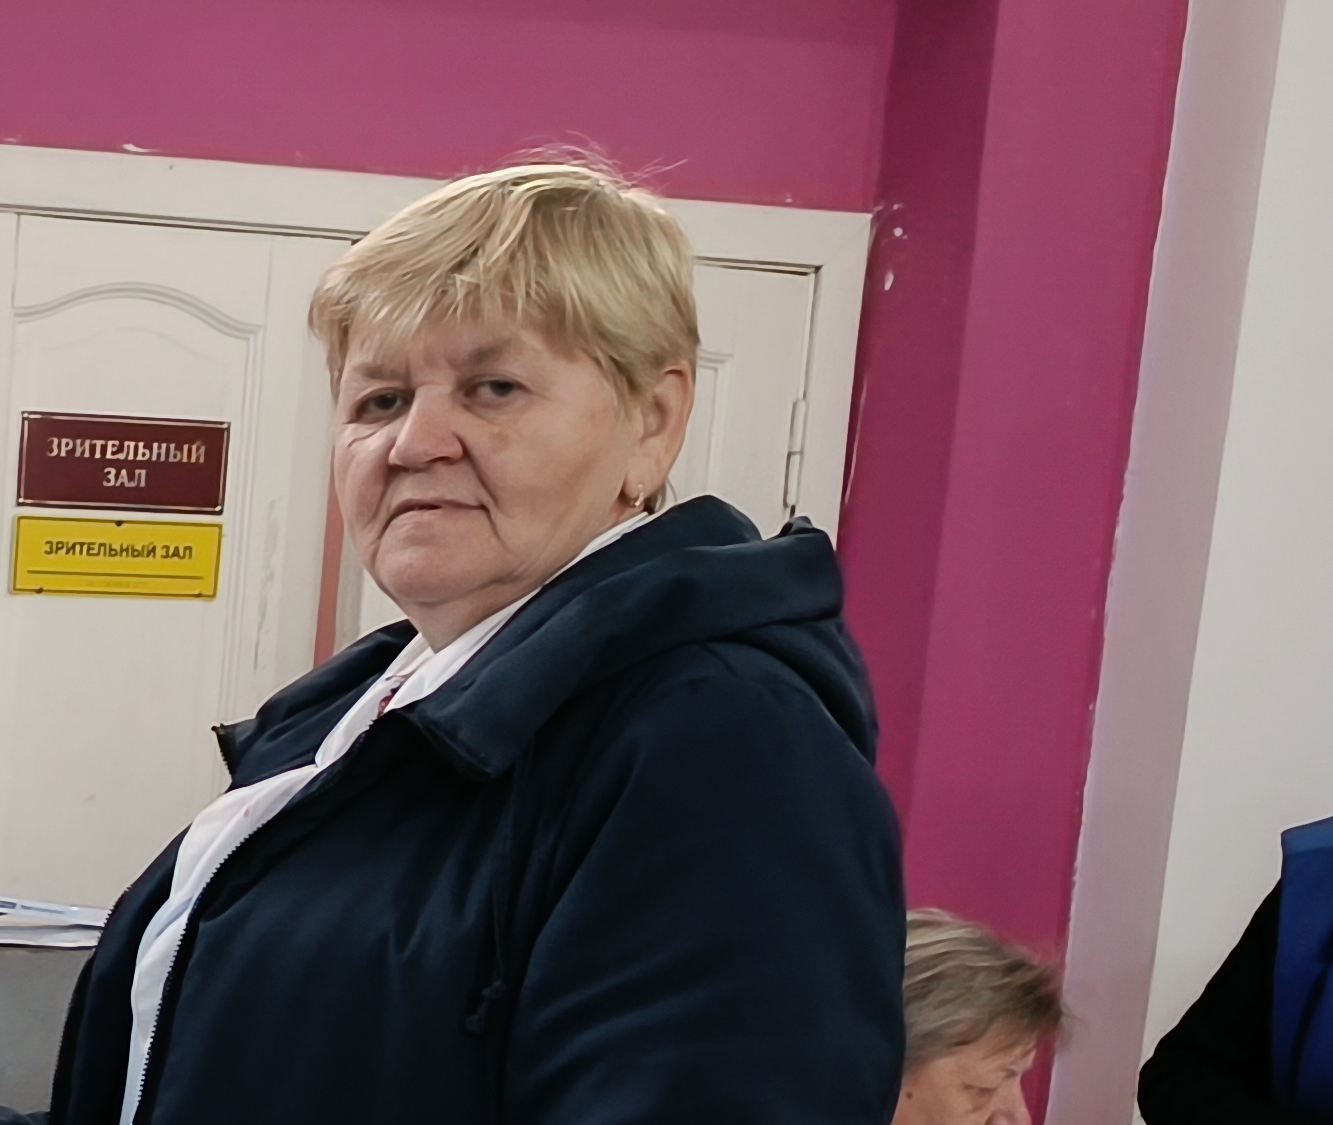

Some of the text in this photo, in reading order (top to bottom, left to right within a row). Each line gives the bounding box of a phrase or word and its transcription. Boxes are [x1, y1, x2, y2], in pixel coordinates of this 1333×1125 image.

[46, 437, 206, 463] ЗРИТЕЛЬНЫЙ
[102, 467, 147, 488] ЗАЛ
[44, 540, 193, 560] ЗРИТЕЛЬНЫЙ ЗАЛ
